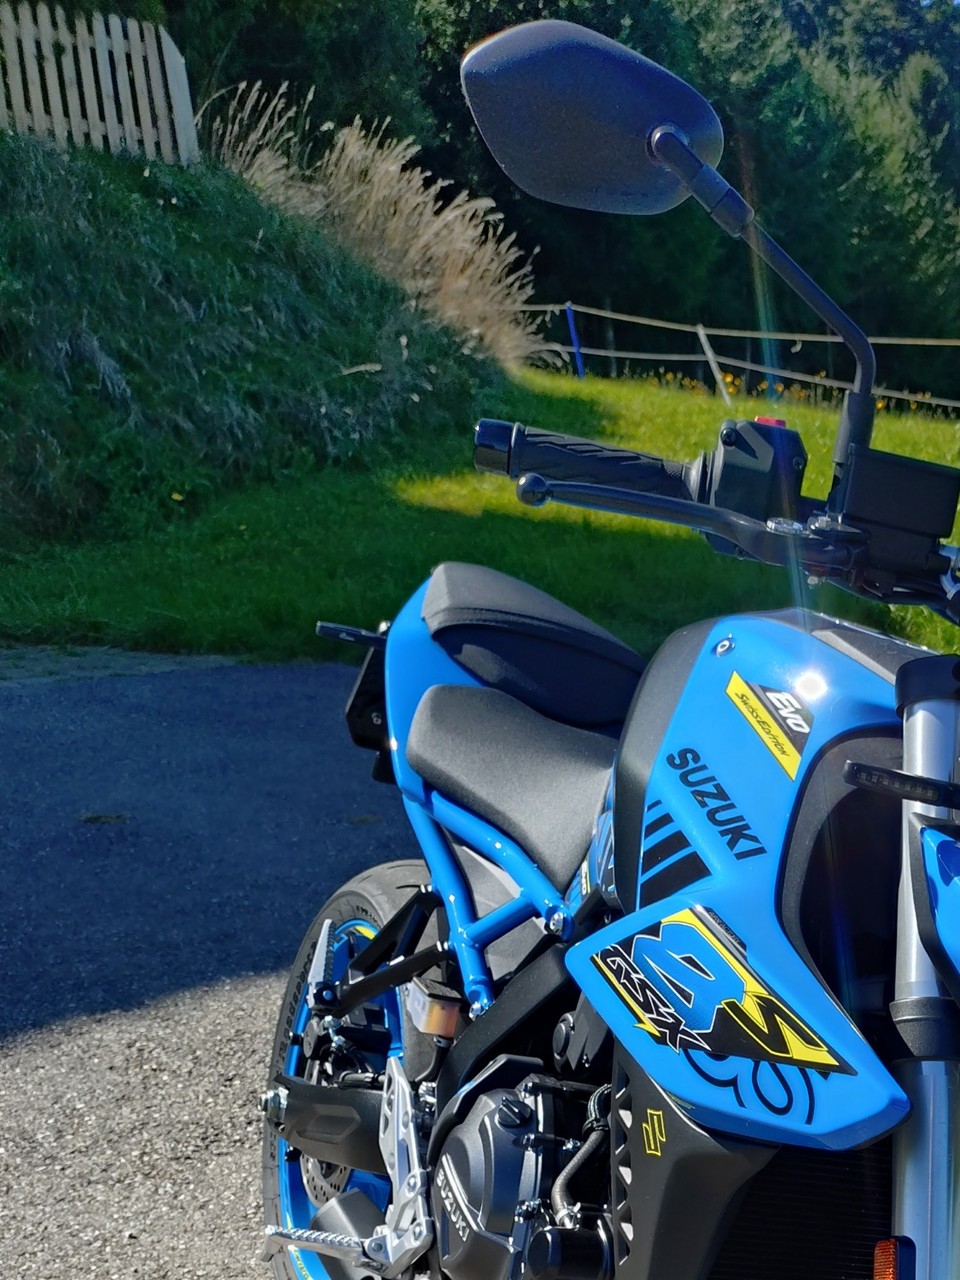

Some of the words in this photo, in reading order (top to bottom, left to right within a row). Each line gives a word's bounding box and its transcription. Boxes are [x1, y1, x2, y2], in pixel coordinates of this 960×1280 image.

[666, 747, 768, 861] SUZUKI
[599, 943, 712, 1055] GSX
[436, 1171, 470, 1242] SUZUKI
